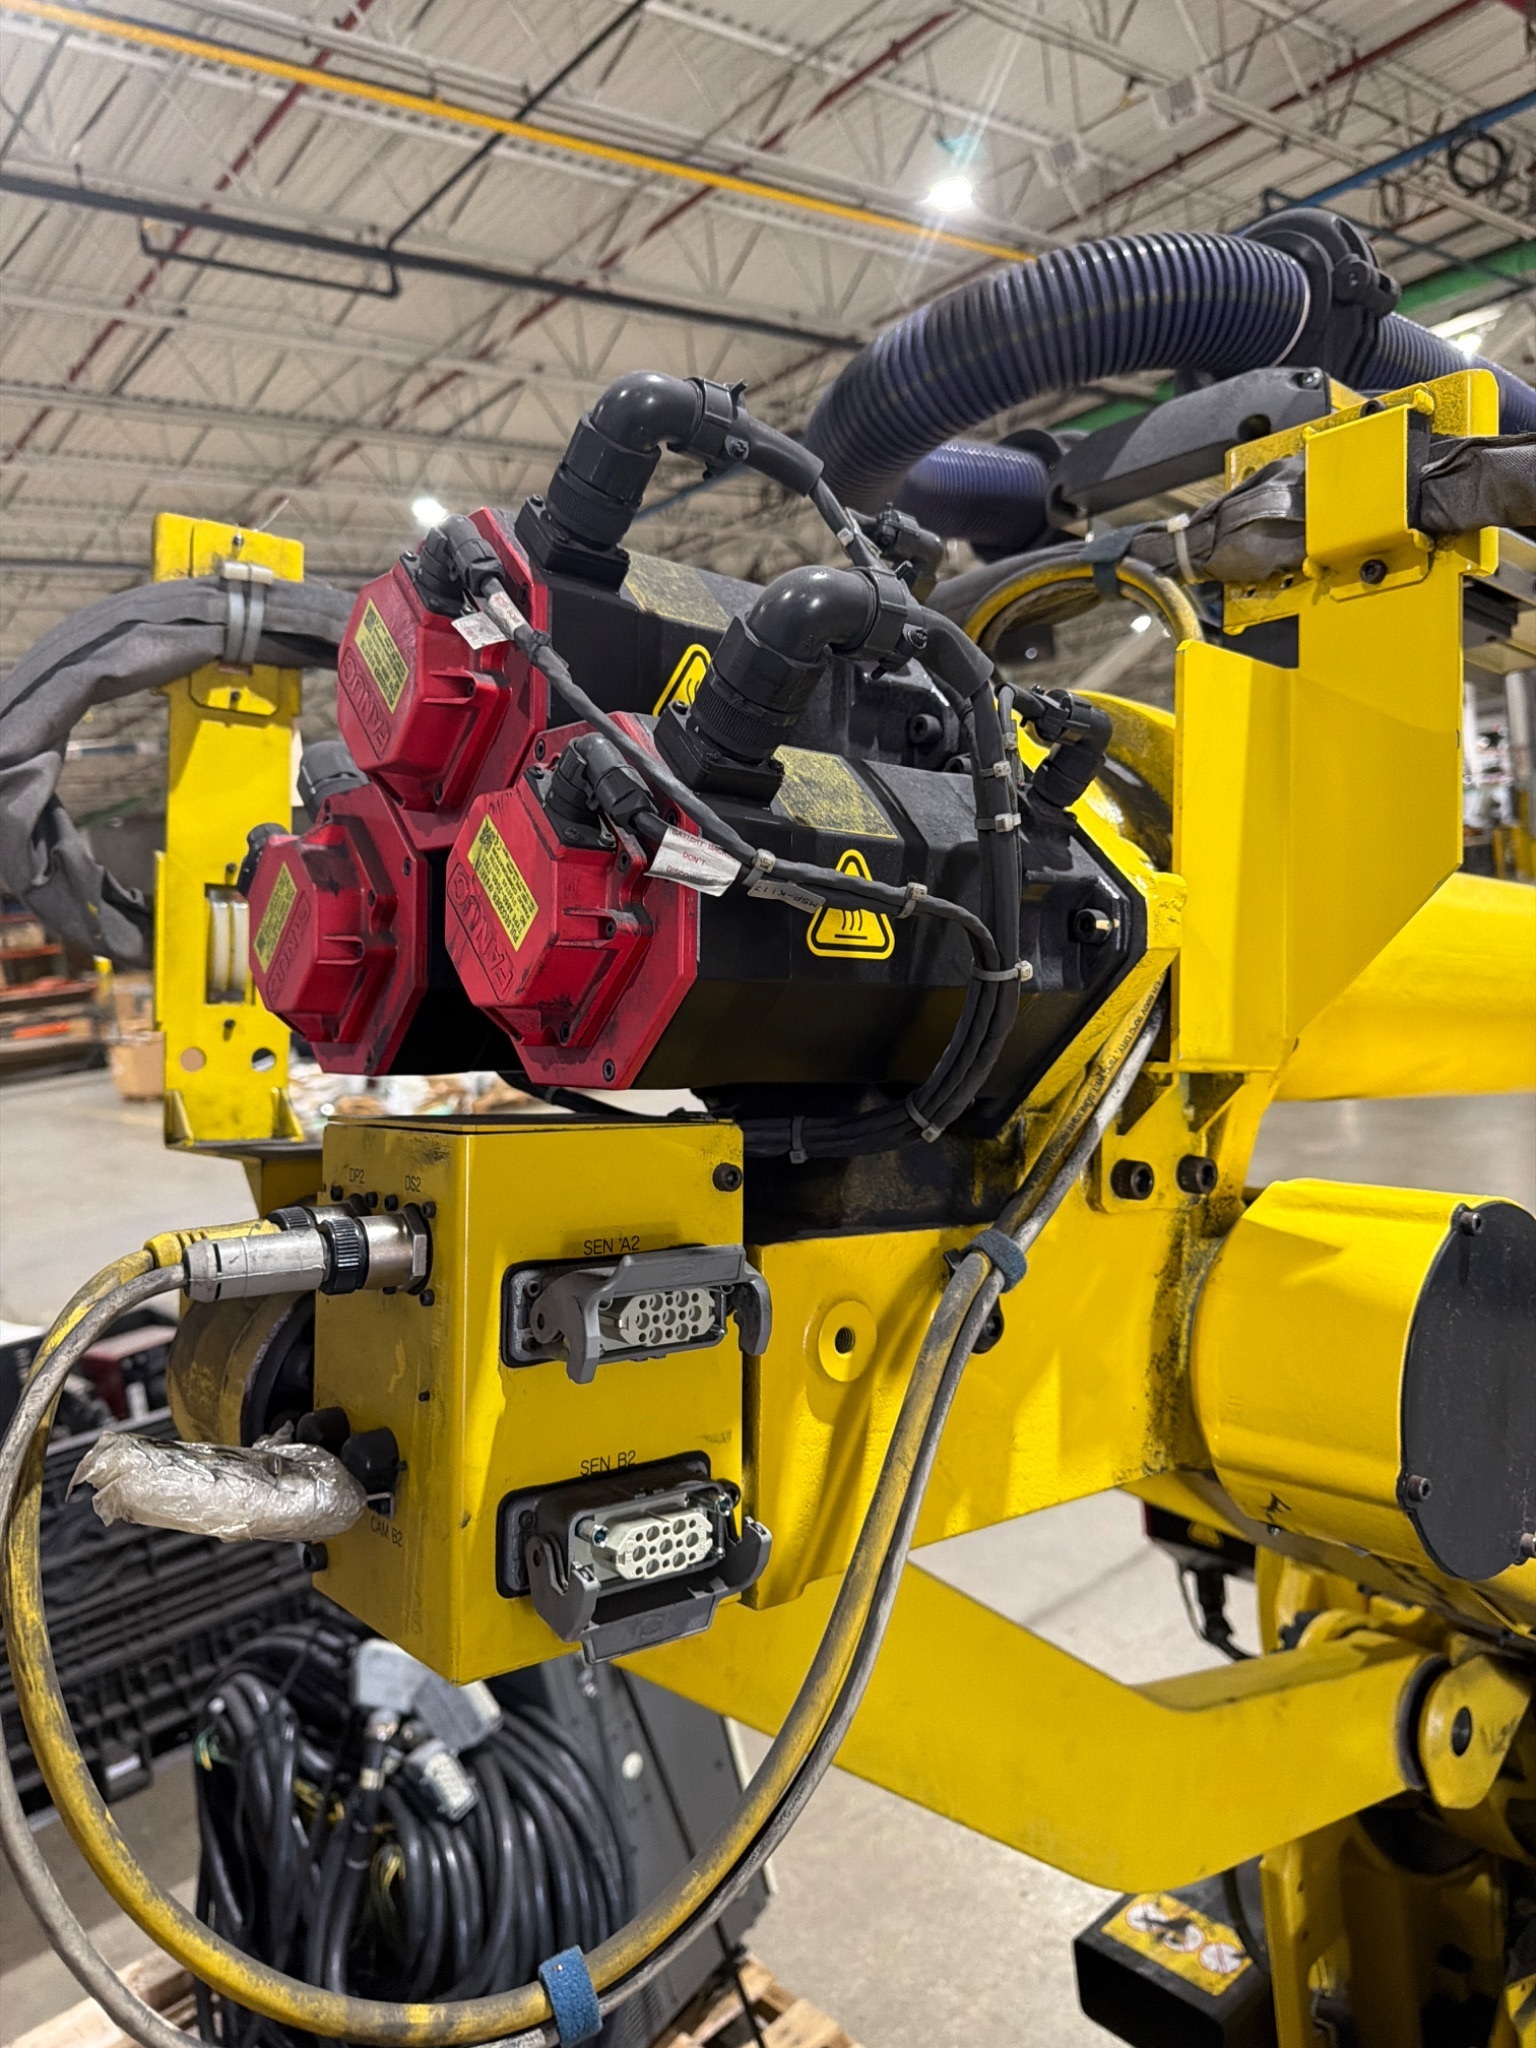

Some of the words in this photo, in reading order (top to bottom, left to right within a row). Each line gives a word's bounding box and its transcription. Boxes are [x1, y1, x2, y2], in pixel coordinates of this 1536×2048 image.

[343, 655, 390, 753] FANUC
[453, 875, 514, 995] FANUC
[348, 1167, 365, 1185] DP2
[404, 1174, 422, 1193] DS2
[583, 1239, 614, 1256] SEN
[620, 1235, 641, 1251] A2
[580, 1455, 612, 1477] SEN
[617, 1449, 637, 1468] B2
[370, 1515, 390, 1537] CAM
[391, 1526, 404, 1548] B2
